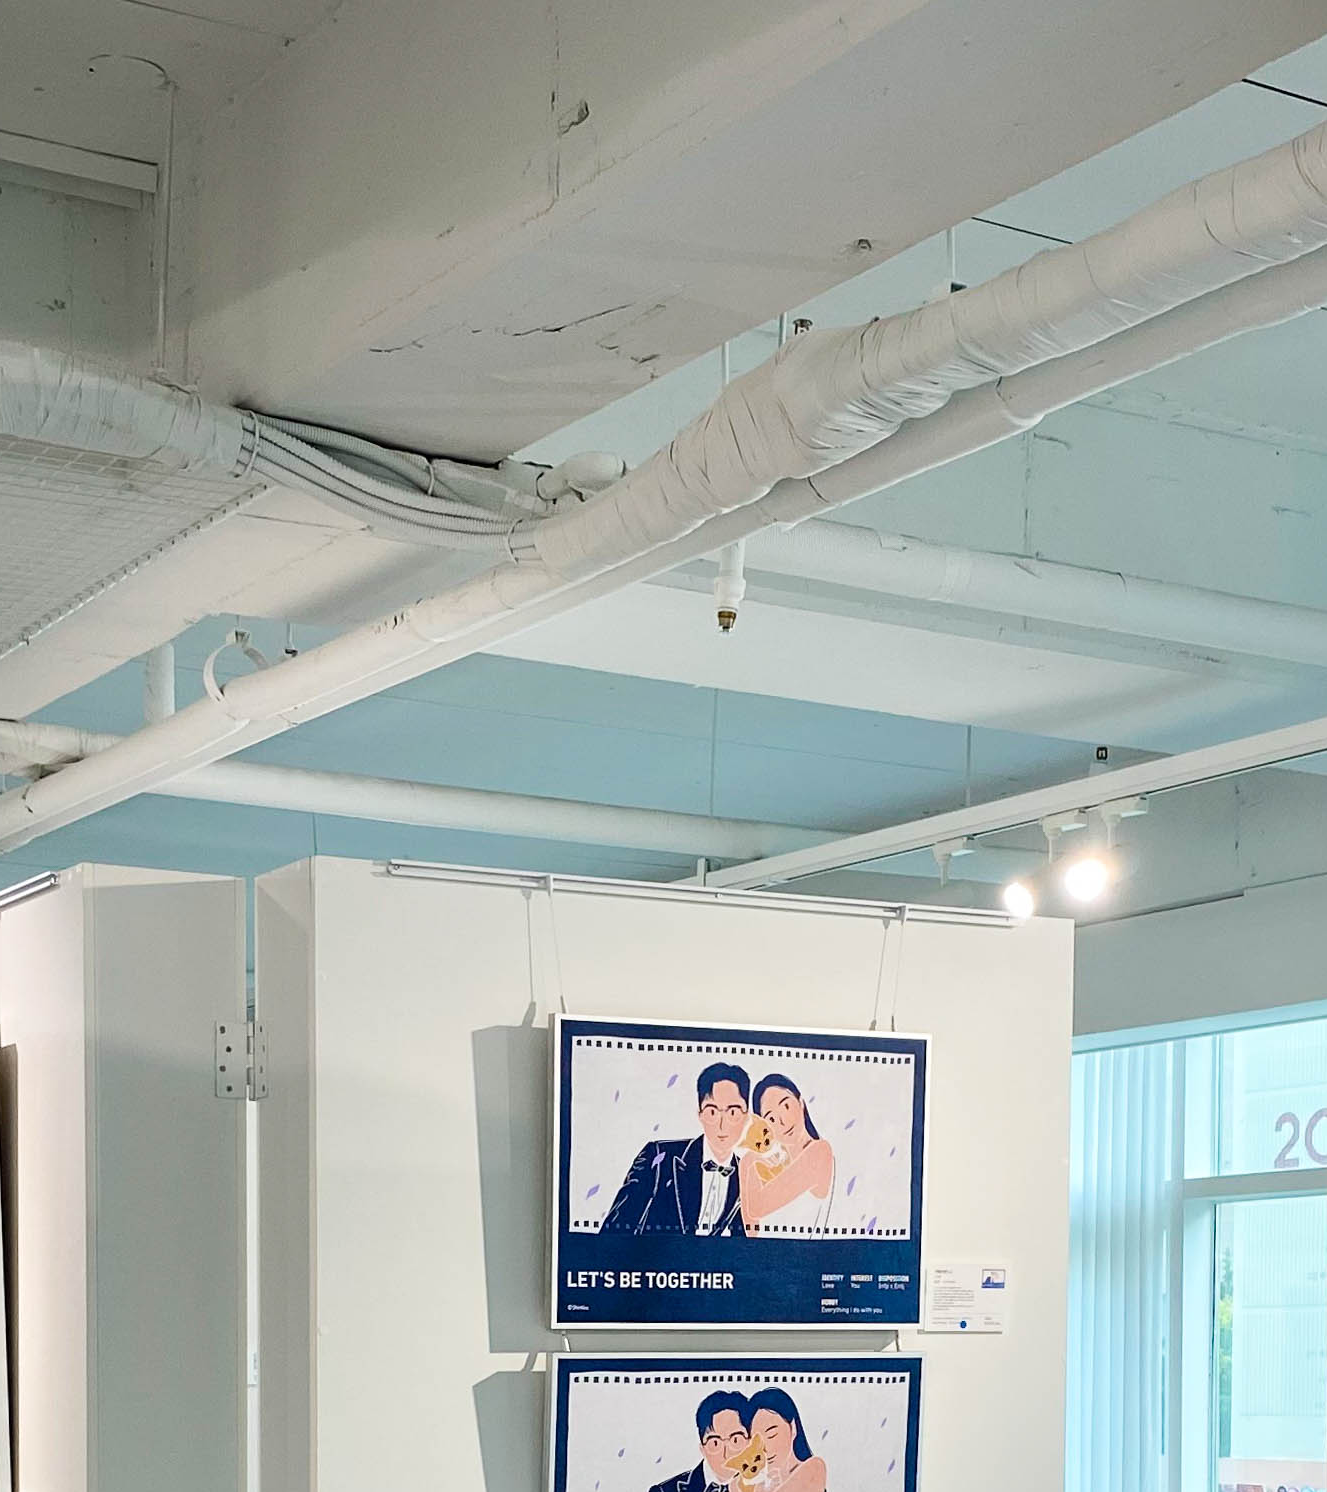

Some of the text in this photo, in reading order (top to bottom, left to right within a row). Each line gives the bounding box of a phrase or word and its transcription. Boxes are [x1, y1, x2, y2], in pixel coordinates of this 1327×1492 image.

[567, 1271, 734, 1289] LET'S BE TOGETHER
